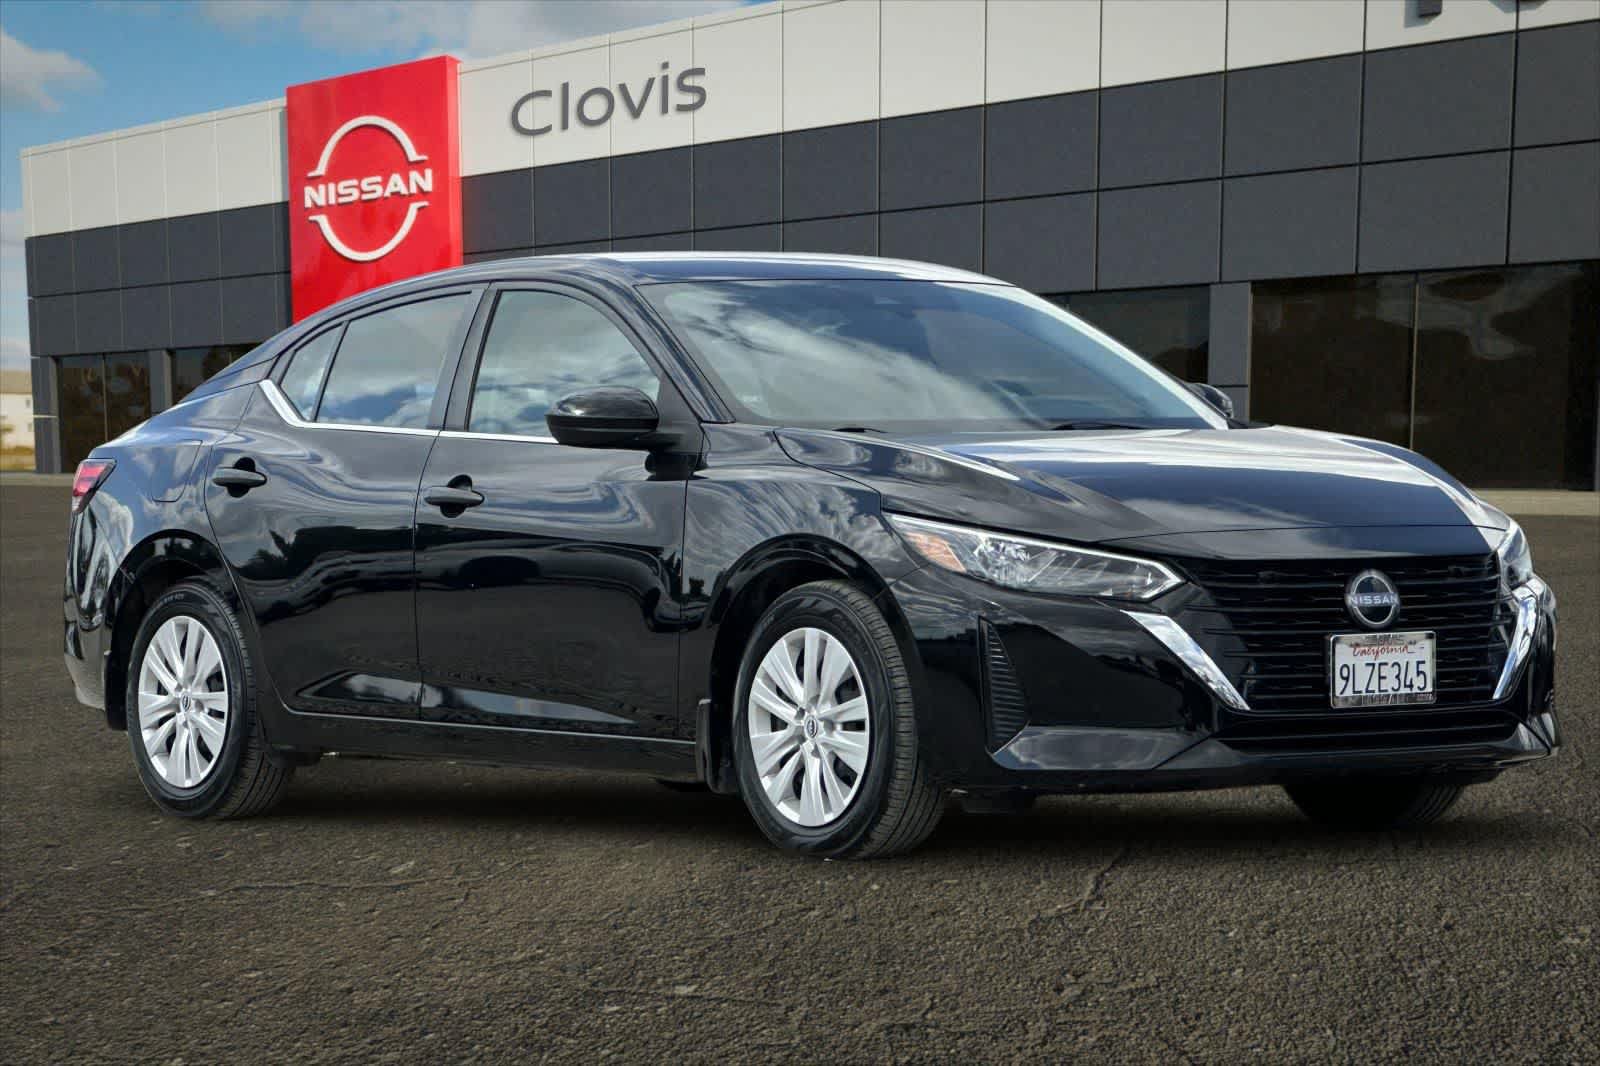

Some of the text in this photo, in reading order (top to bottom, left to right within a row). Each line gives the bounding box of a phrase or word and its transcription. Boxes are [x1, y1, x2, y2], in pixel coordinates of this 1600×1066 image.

[511, 61, 707, 136] Clovis
[304, 169, 432, 208] NISSAN
[1348, 594, 1398, 605] NISSAN
[1339, 660, 1427, 695] 9LZE345
